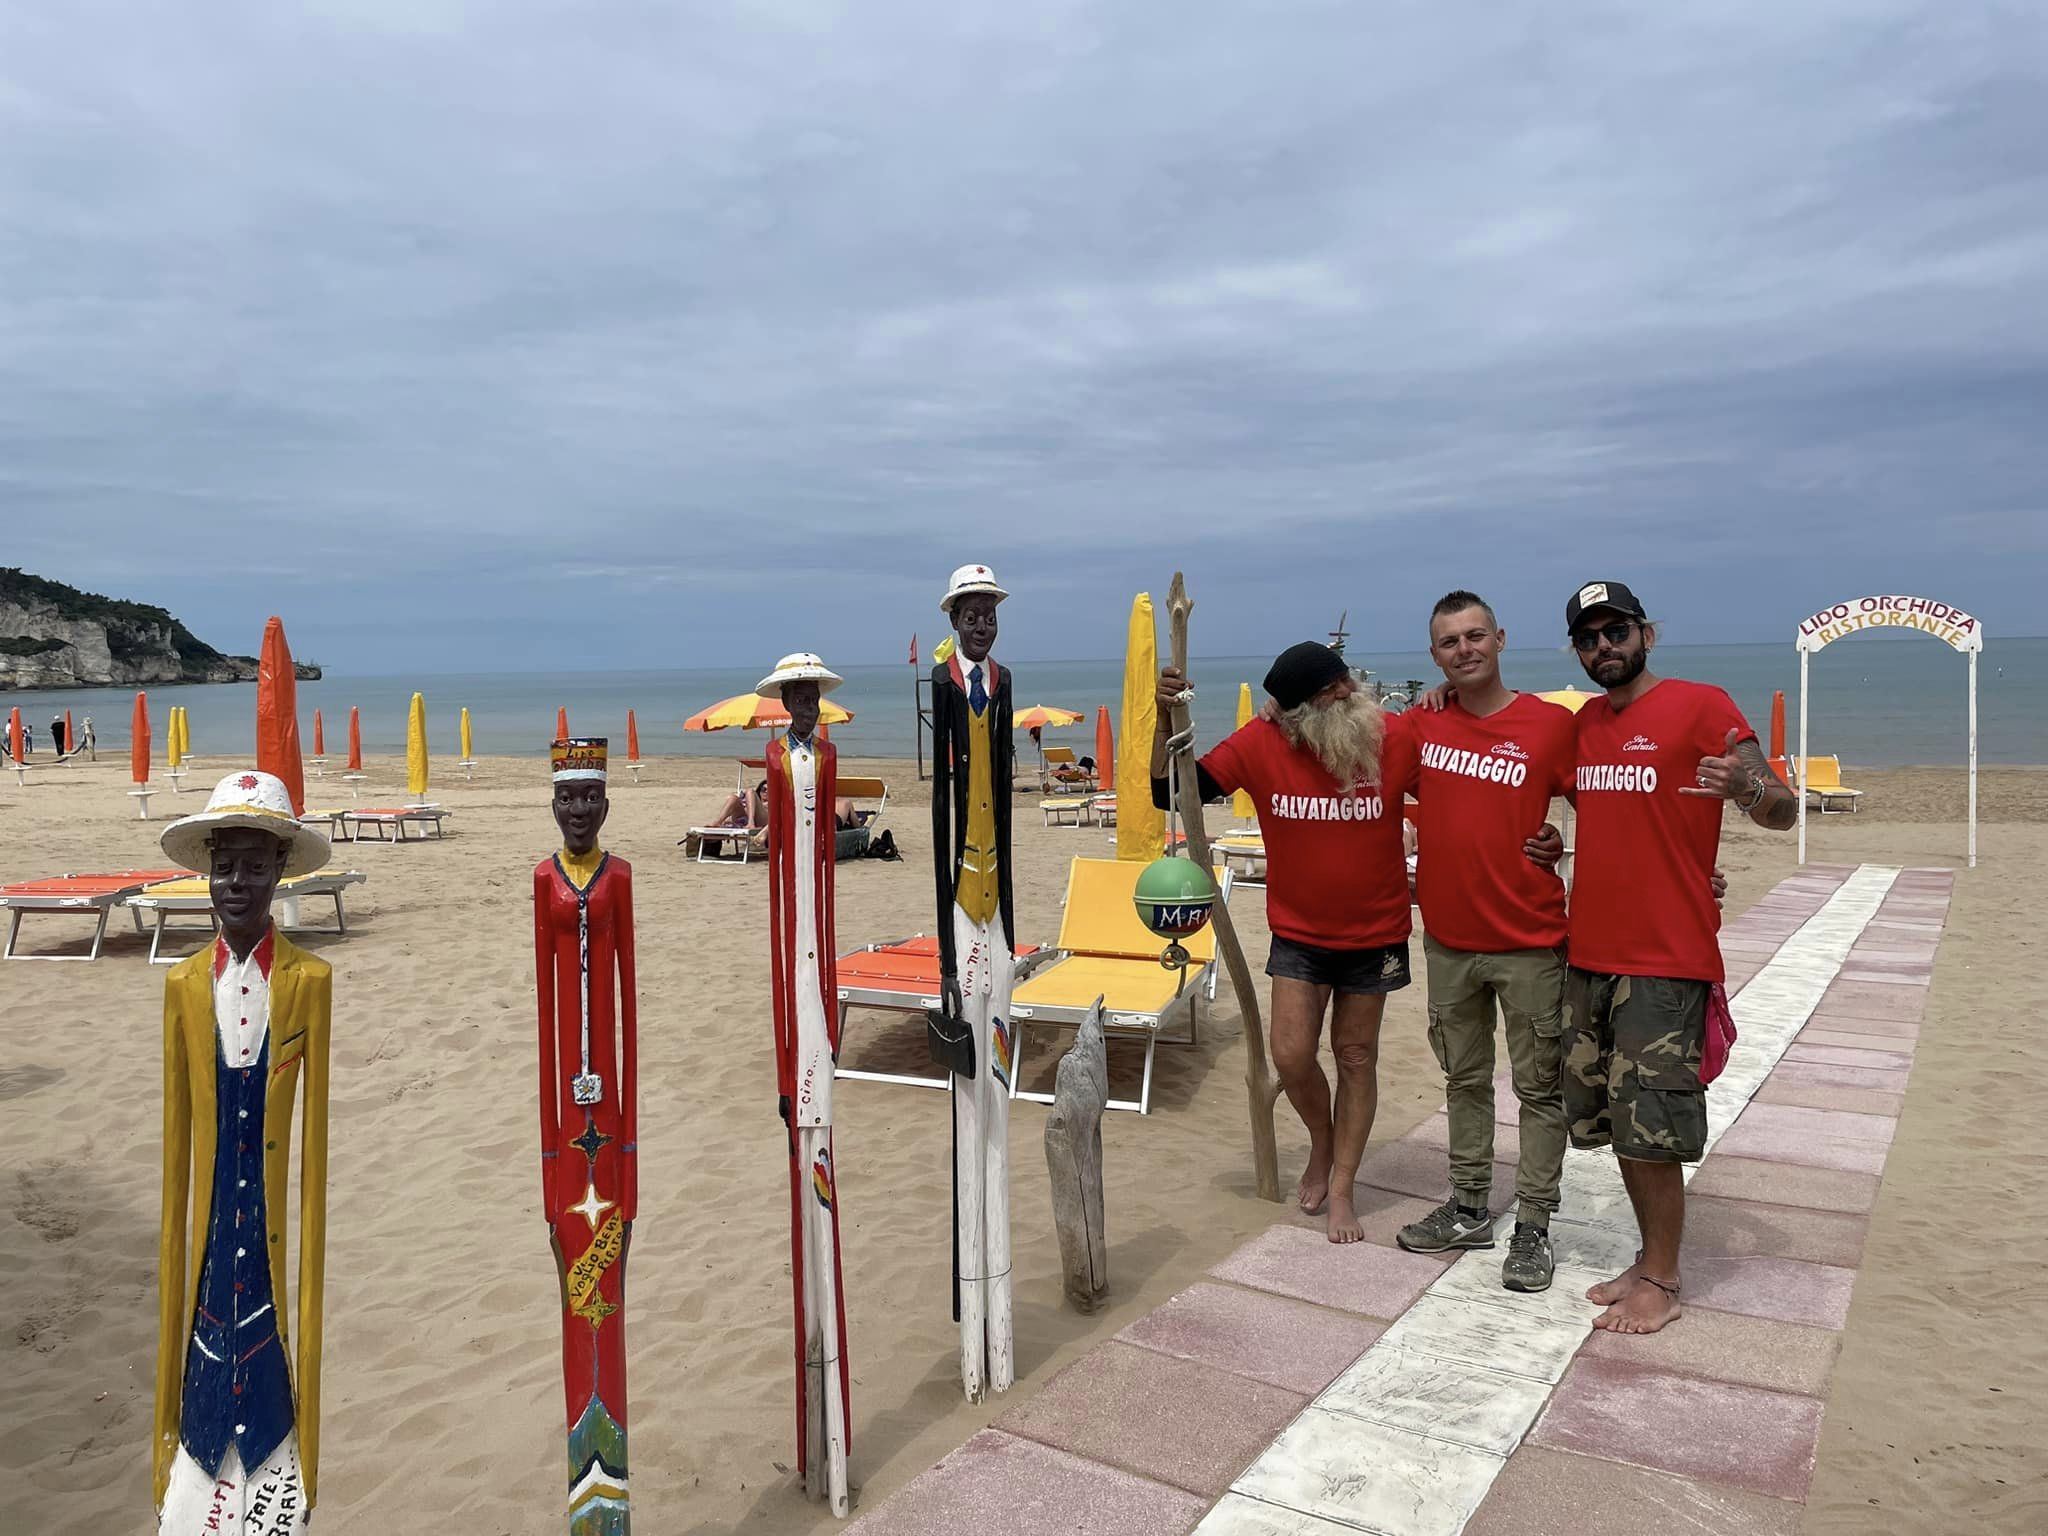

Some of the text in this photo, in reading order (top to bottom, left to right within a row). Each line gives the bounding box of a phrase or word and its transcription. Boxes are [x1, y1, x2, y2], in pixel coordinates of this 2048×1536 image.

[1799, 596, 1976, 637] LIDO ORCHIDEA
[1818, 611, 1967, 647] RISTORANTE
[1271, 793, 1384, 821] SALVATAGGIO
